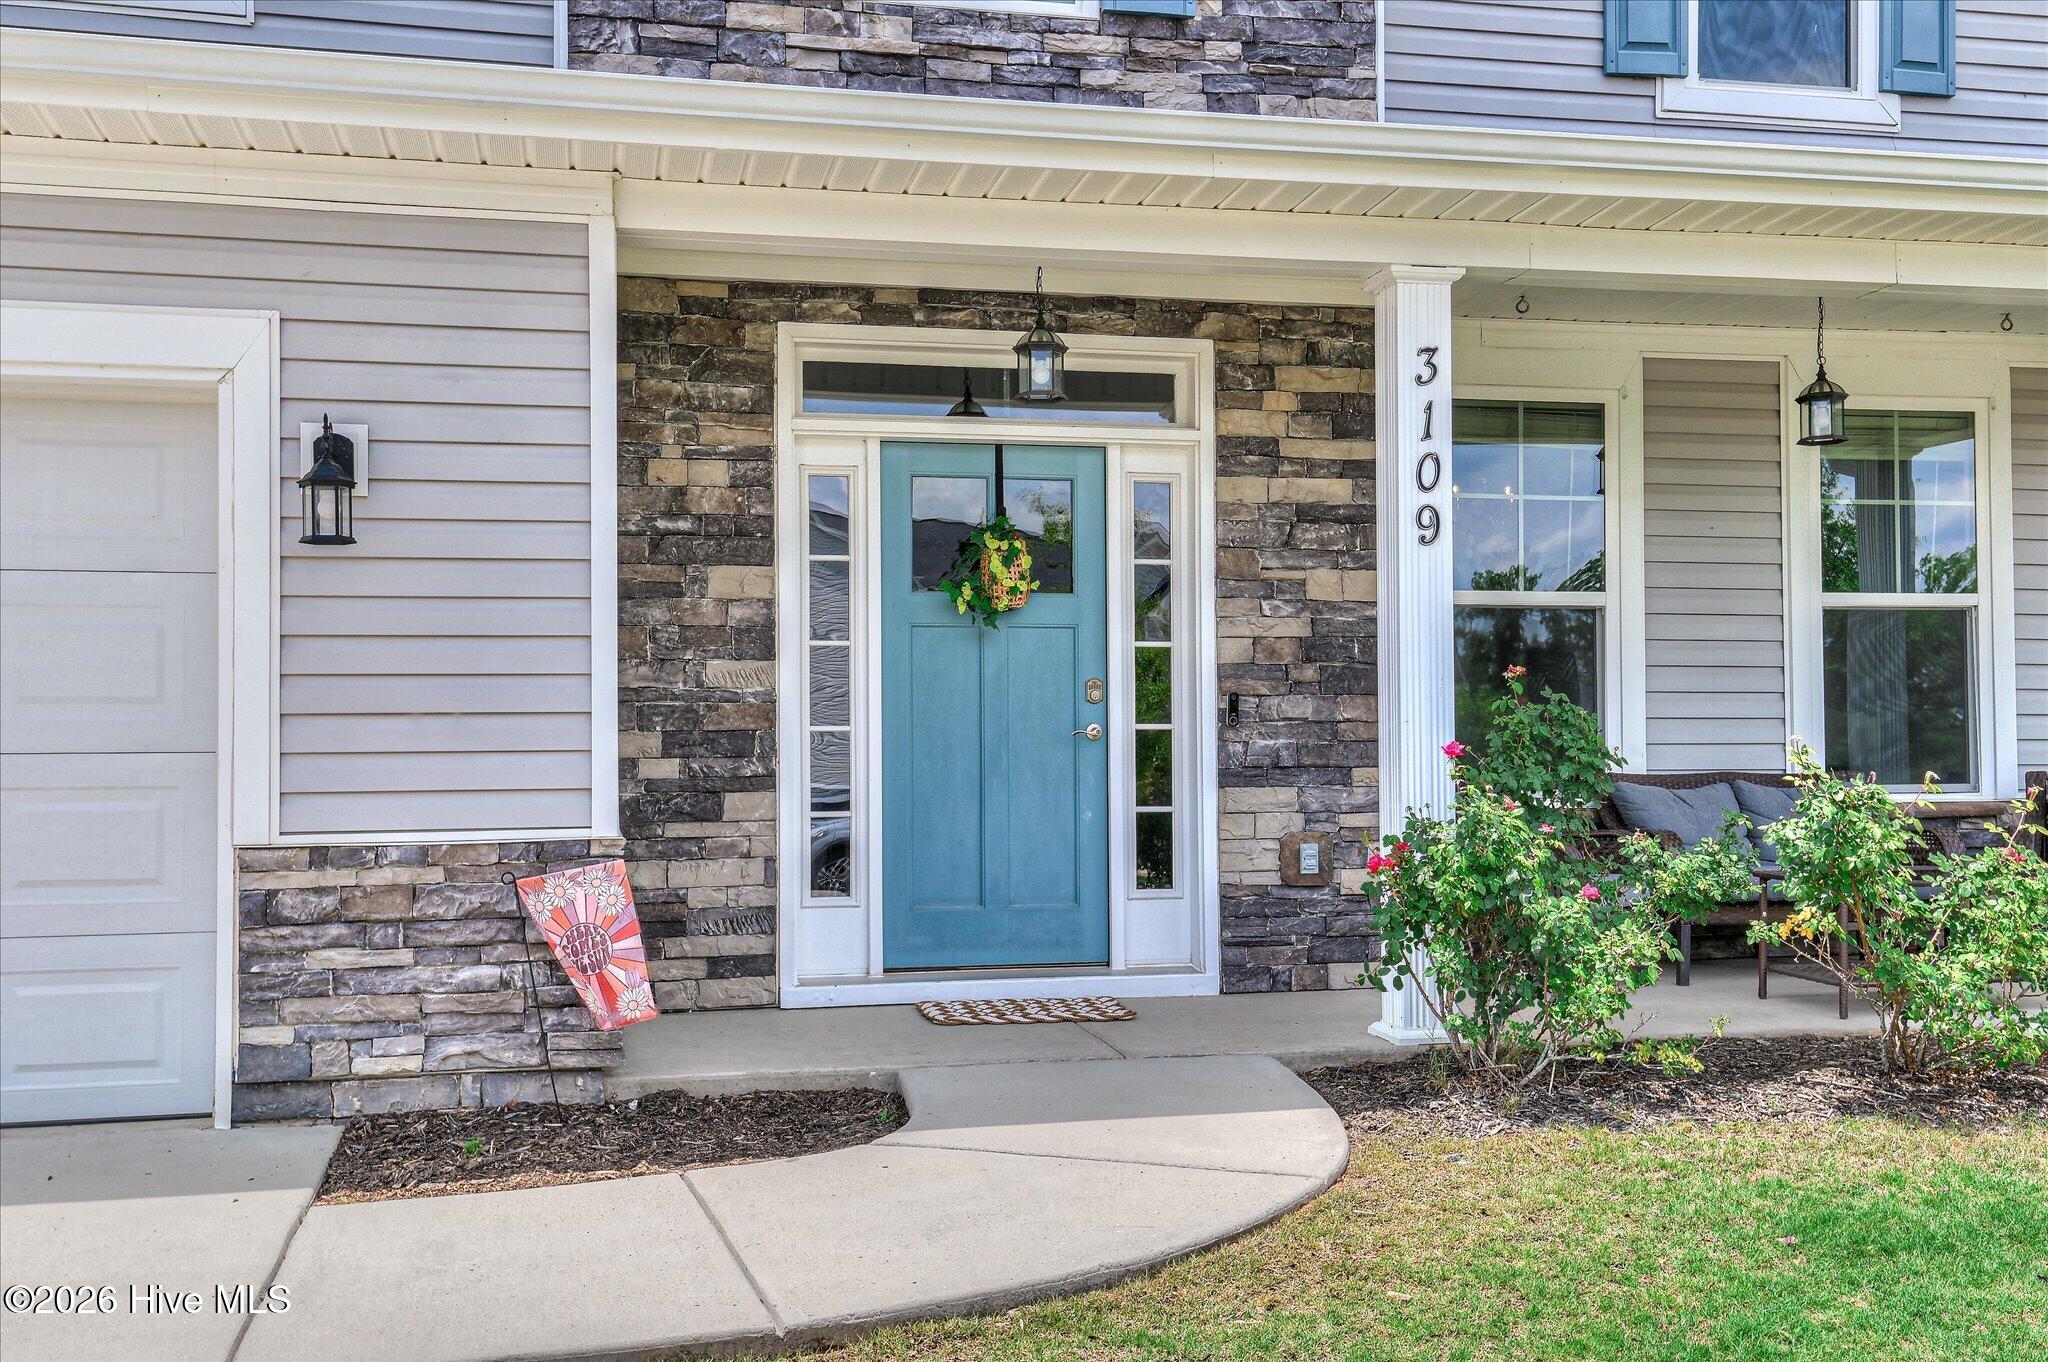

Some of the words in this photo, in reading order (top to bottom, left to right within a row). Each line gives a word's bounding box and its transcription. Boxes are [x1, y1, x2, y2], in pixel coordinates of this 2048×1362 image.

[1415, 345, 1441, 546] 3109
[561, 933, 608, 959] COMES
[565, 924, 601, 945] HERE
[587, 944, 611, 974] SUN
